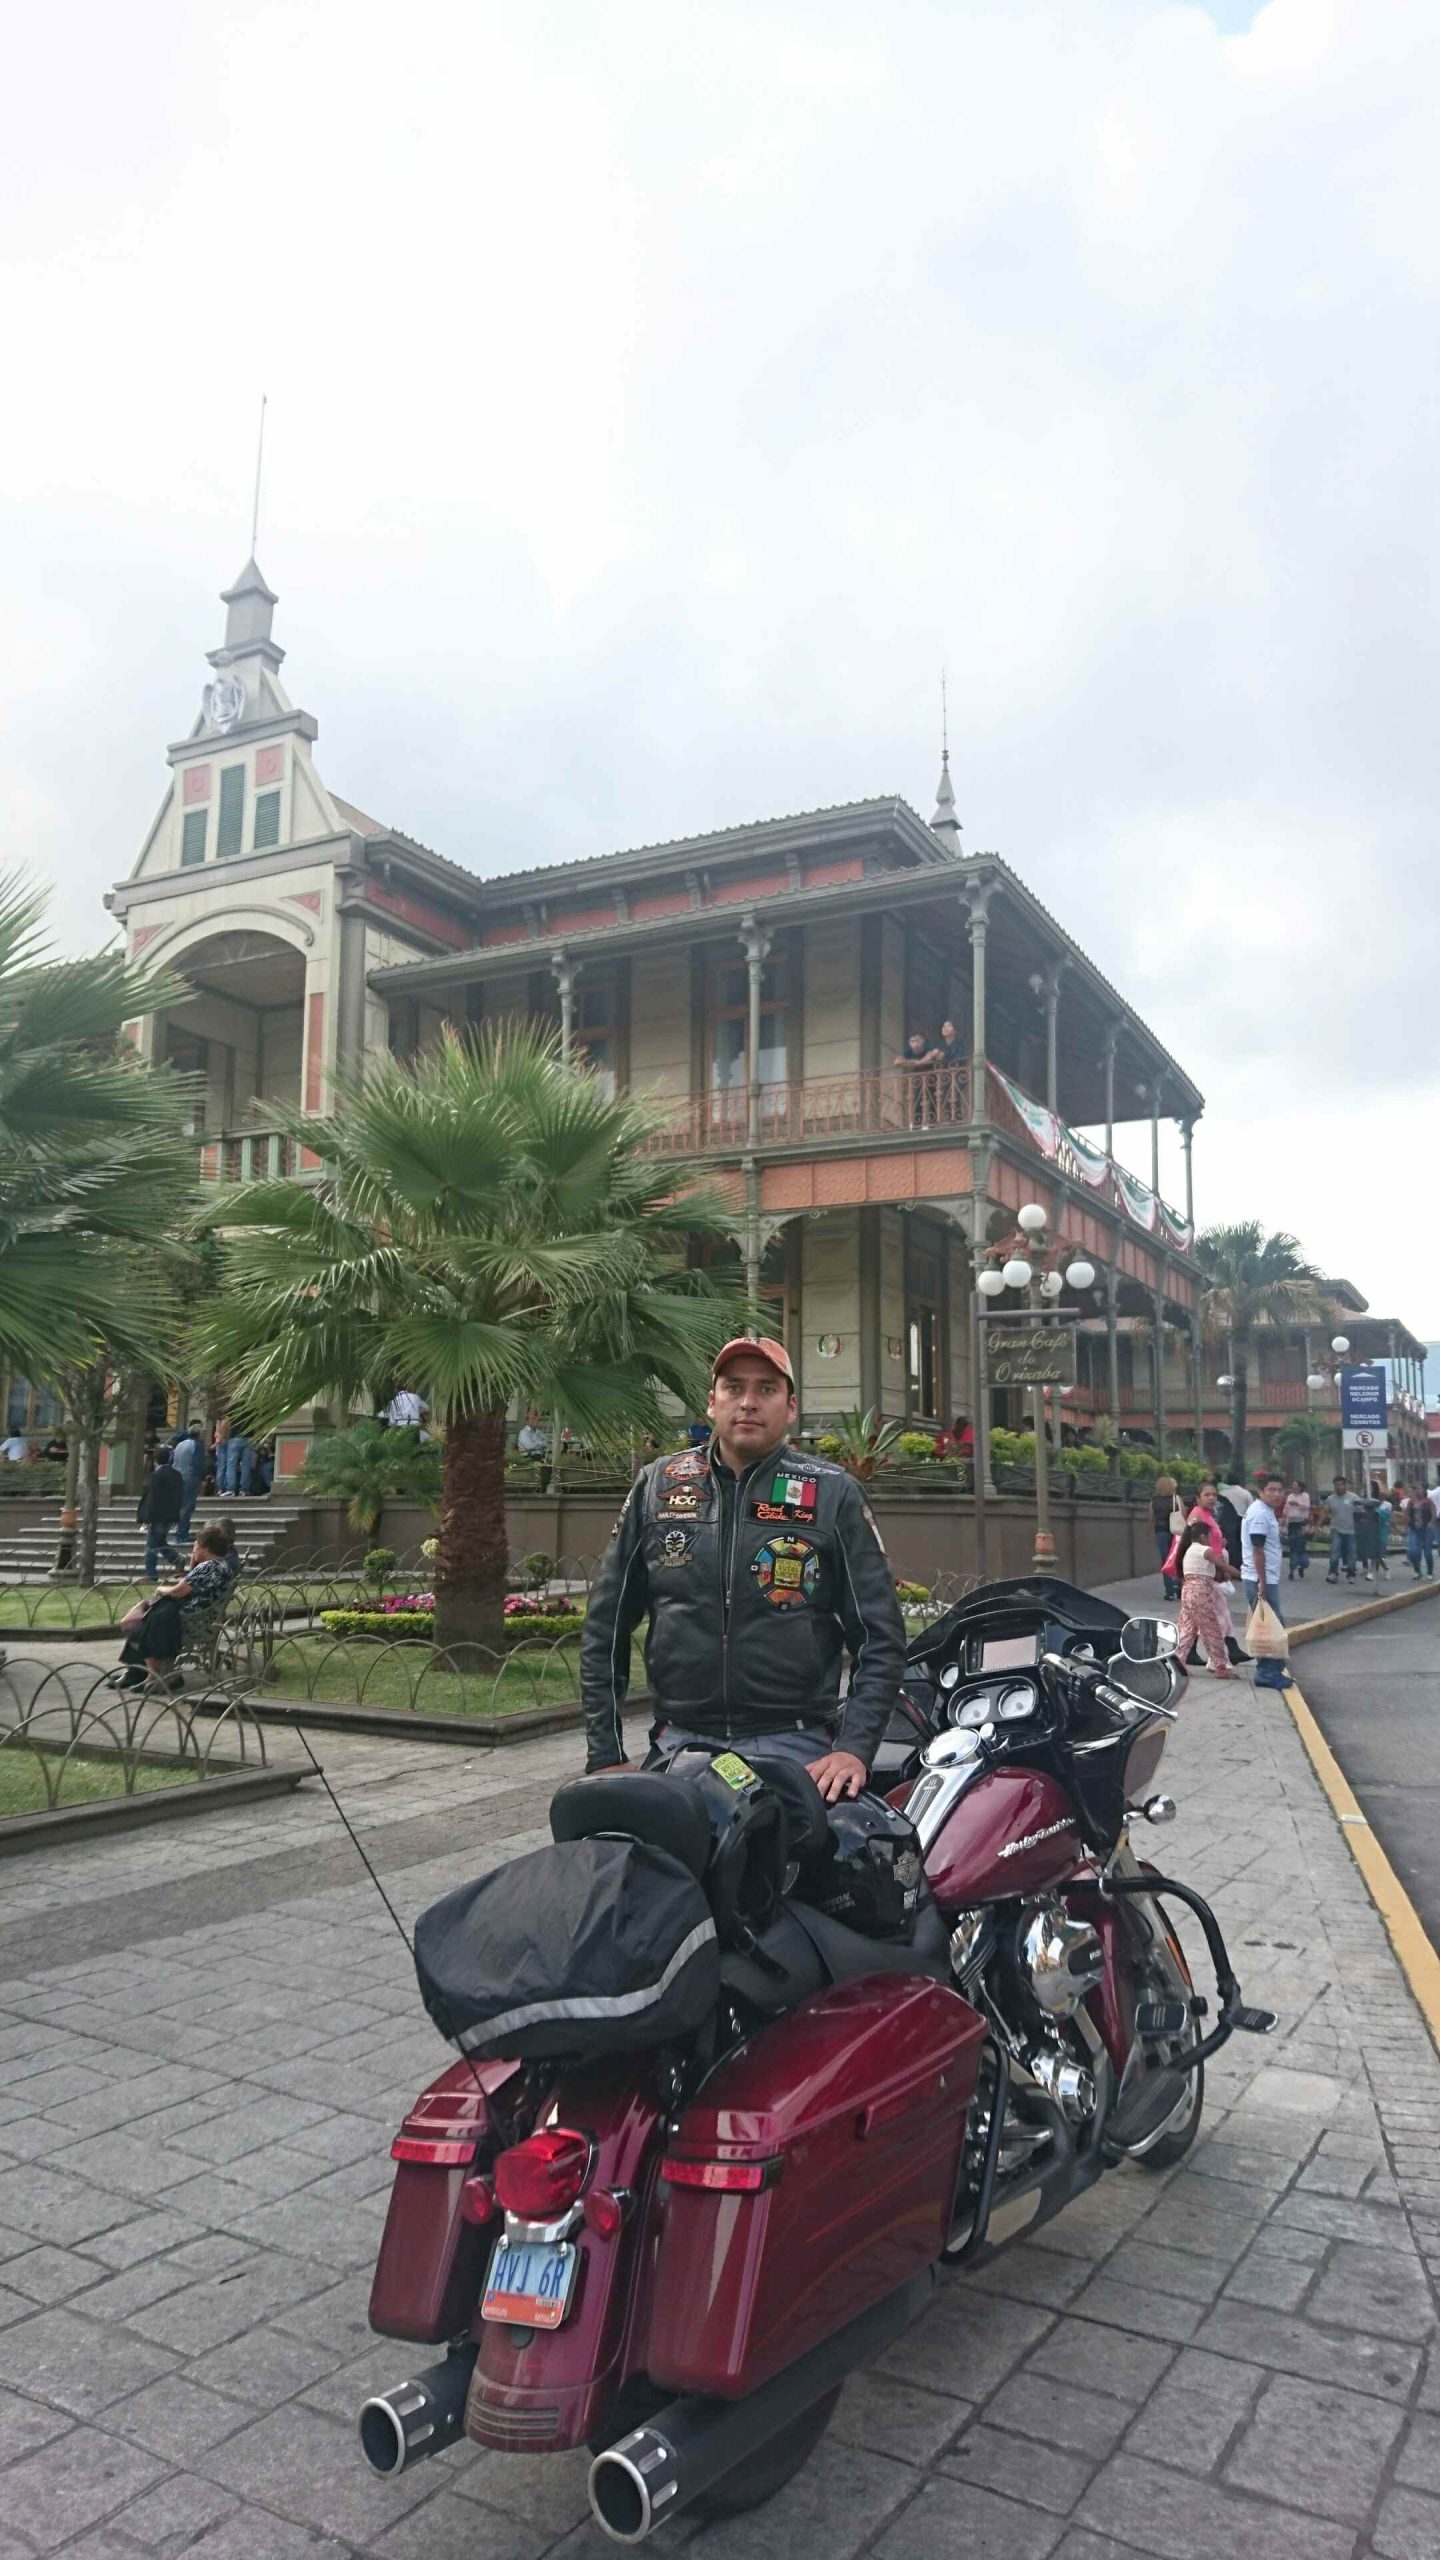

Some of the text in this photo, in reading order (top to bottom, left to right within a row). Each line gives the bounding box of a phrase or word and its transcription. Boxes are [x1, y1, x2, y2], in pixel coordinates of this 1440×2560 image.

[988, 1331, 1028, 1354] Gran
[1018, 1350, 1036, 1365] de
[995, 1361, 1061, 1383] Orizaba
[776, 1472, 817, 1484] MEXICO
[669, 1495, 697, 1506] HOG
[492, 2254, 566, 2298] HVJ 6R
